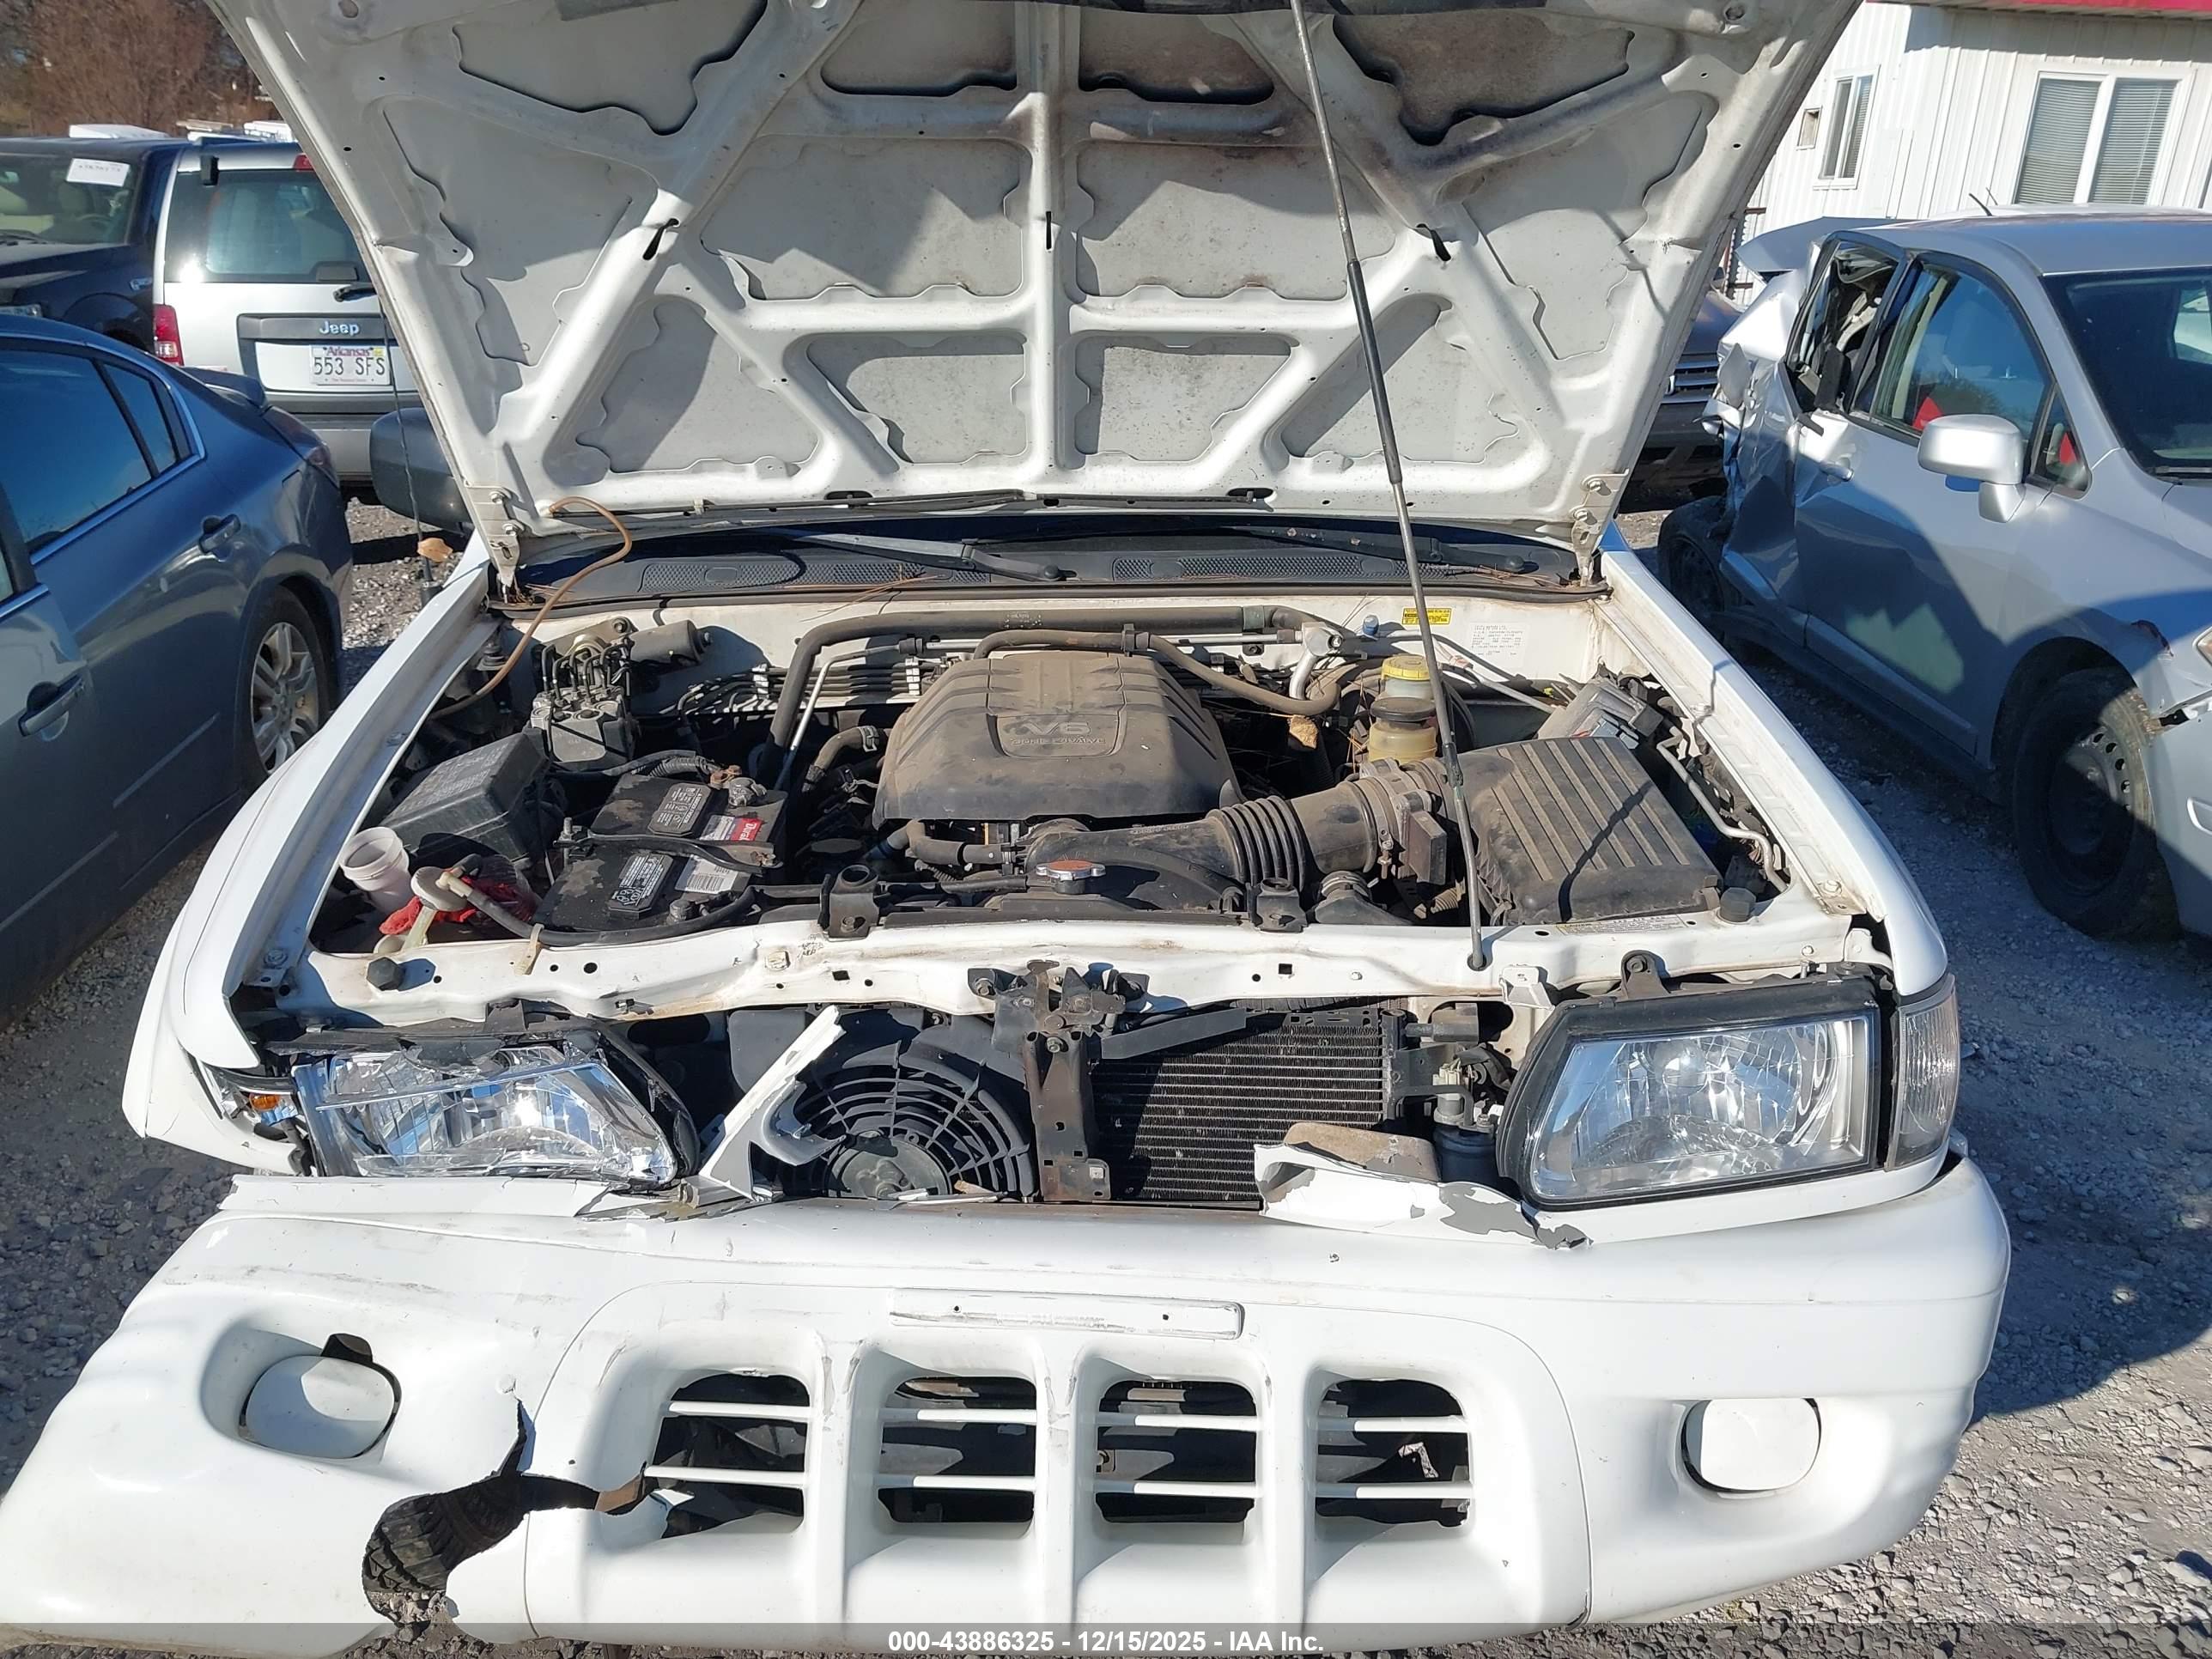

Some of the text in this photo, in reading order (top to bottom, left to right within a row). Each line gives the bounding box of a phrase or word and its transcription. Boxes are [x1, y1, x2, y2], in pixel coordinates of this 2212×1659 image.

[319, 320, 360, 336] Jeep
[327, 346, 370, 356] Arkansas
[314, 357, 386, 375] 553 SFS
[1021, 721, 1091, 735] V6
